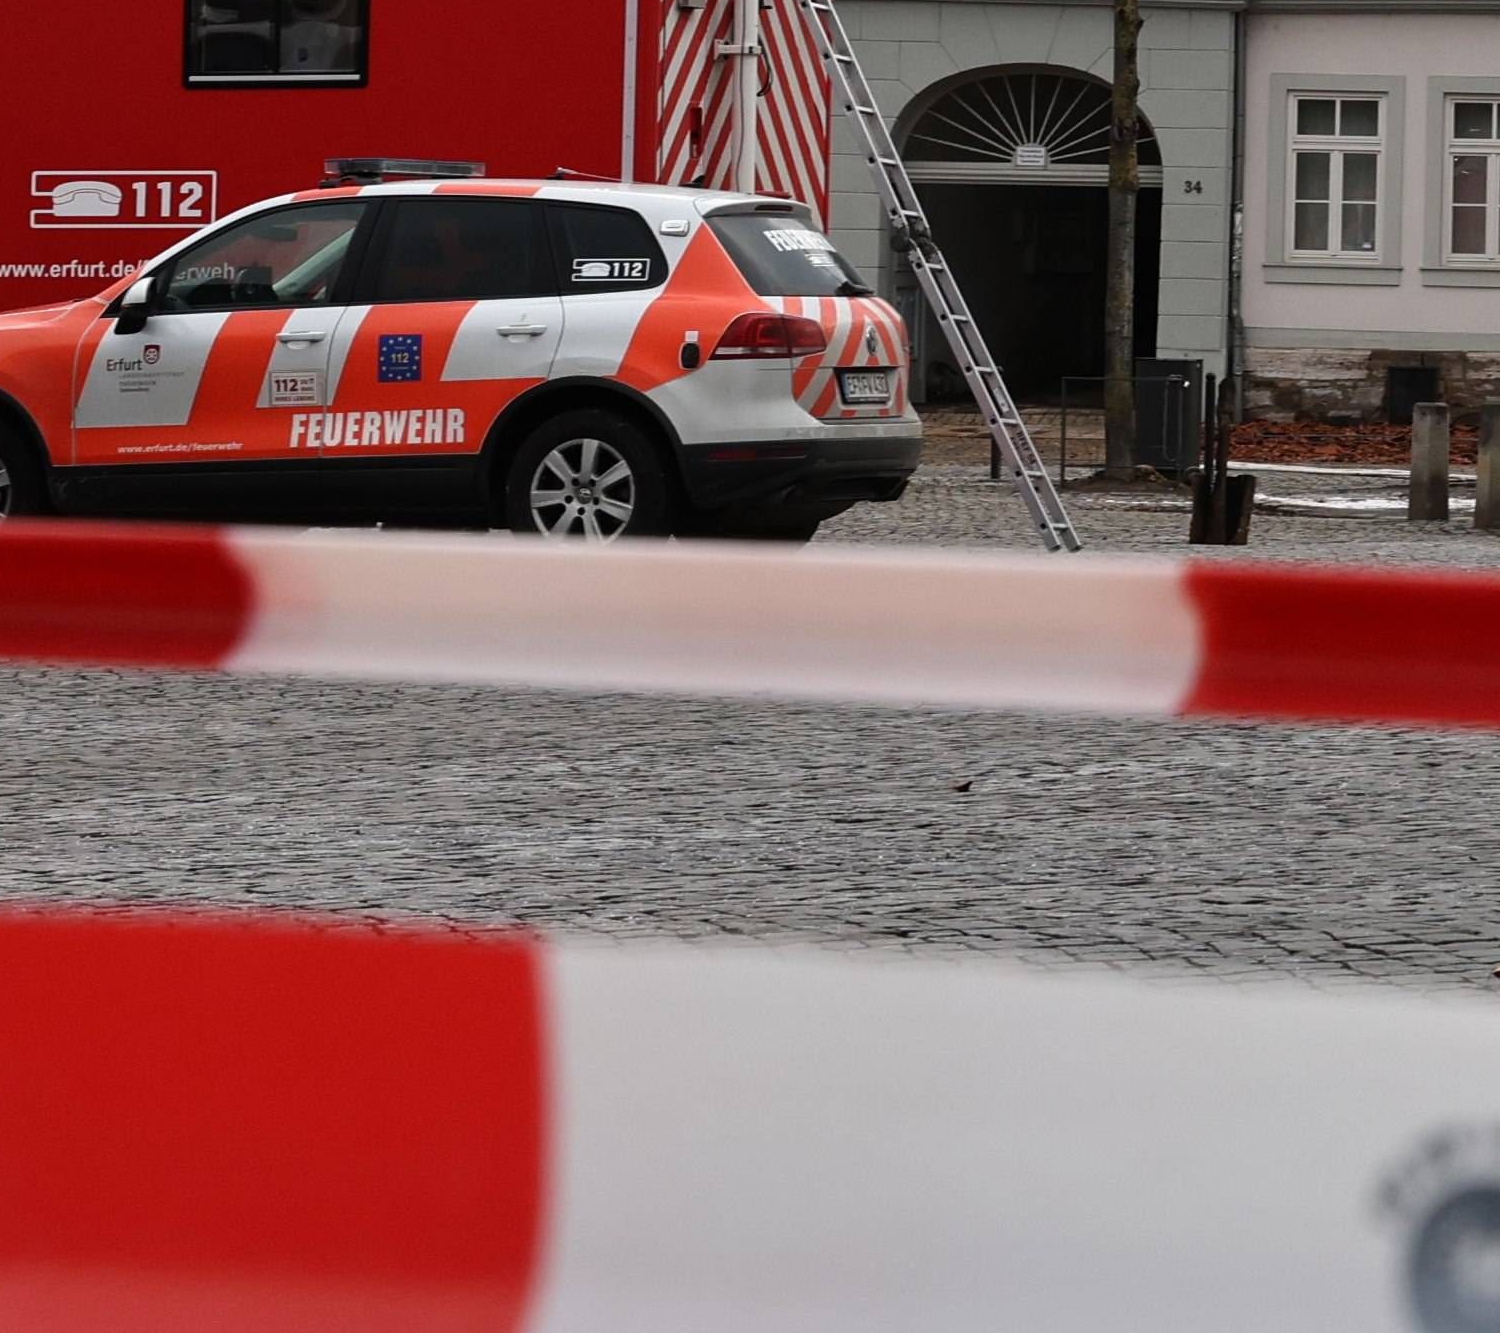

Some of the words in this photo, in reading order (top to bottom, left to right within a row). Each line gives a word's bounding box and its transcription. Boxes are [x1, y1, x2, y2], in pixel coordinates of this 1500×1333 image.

[1184, 180, 1203, 194] 34
[131, 181, 204, 218] 112
[611, 261, 644, 278] 112
[391, 352, 409, 363] 112
[106, 358, 143, 372] Erfurt
[275, 378, 298, 392] 112
[290, 408, 465, 448] FEUERWEHR
[117, 441, 243, 454] www.erfurt.de/feuerwehr
